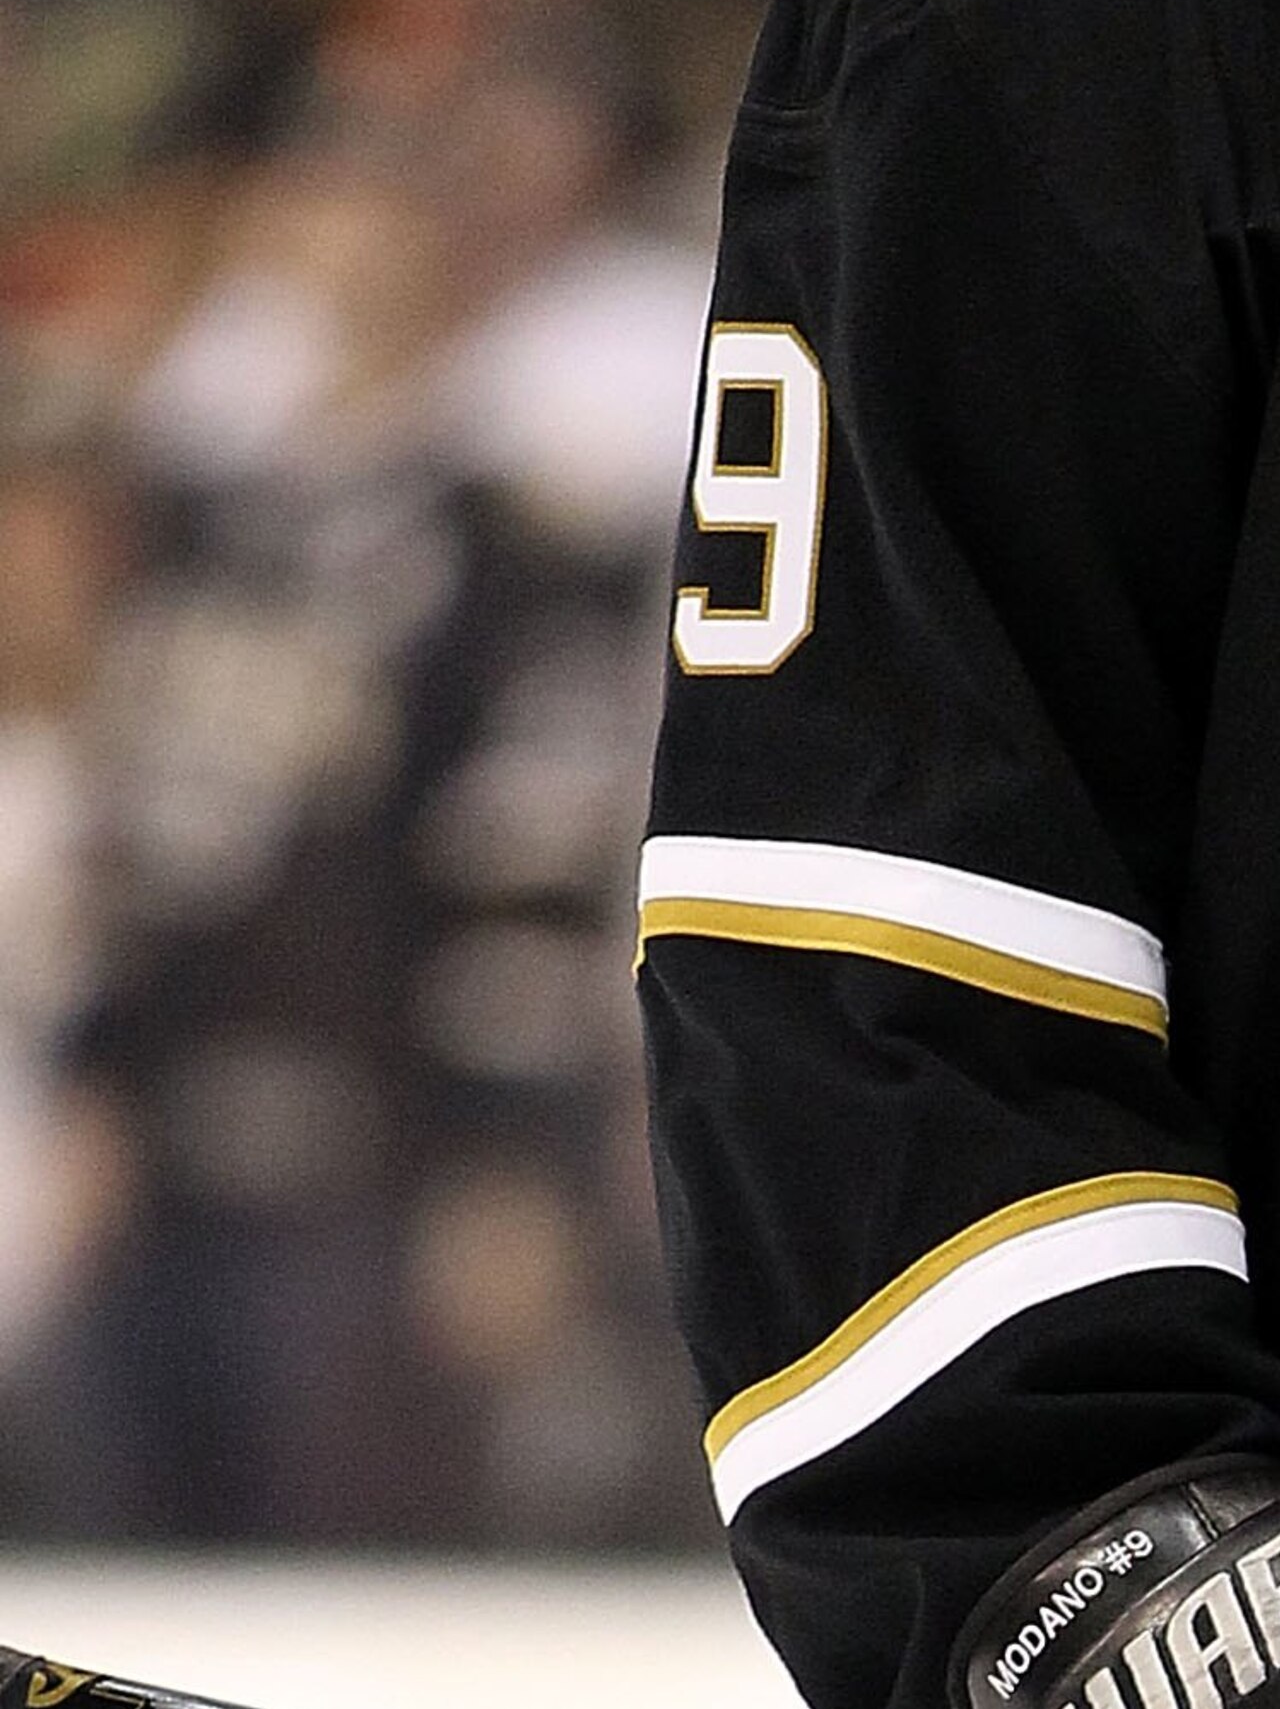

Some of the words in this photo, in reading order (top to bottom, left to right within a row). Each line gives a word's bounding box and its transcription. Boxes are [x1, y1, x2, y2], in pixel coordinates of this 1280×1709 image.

[672, 321, 830, 677] 9
[987, 1567, 1104, 1700] MODANO
[1100, 1529, 1154, 1576] #9
